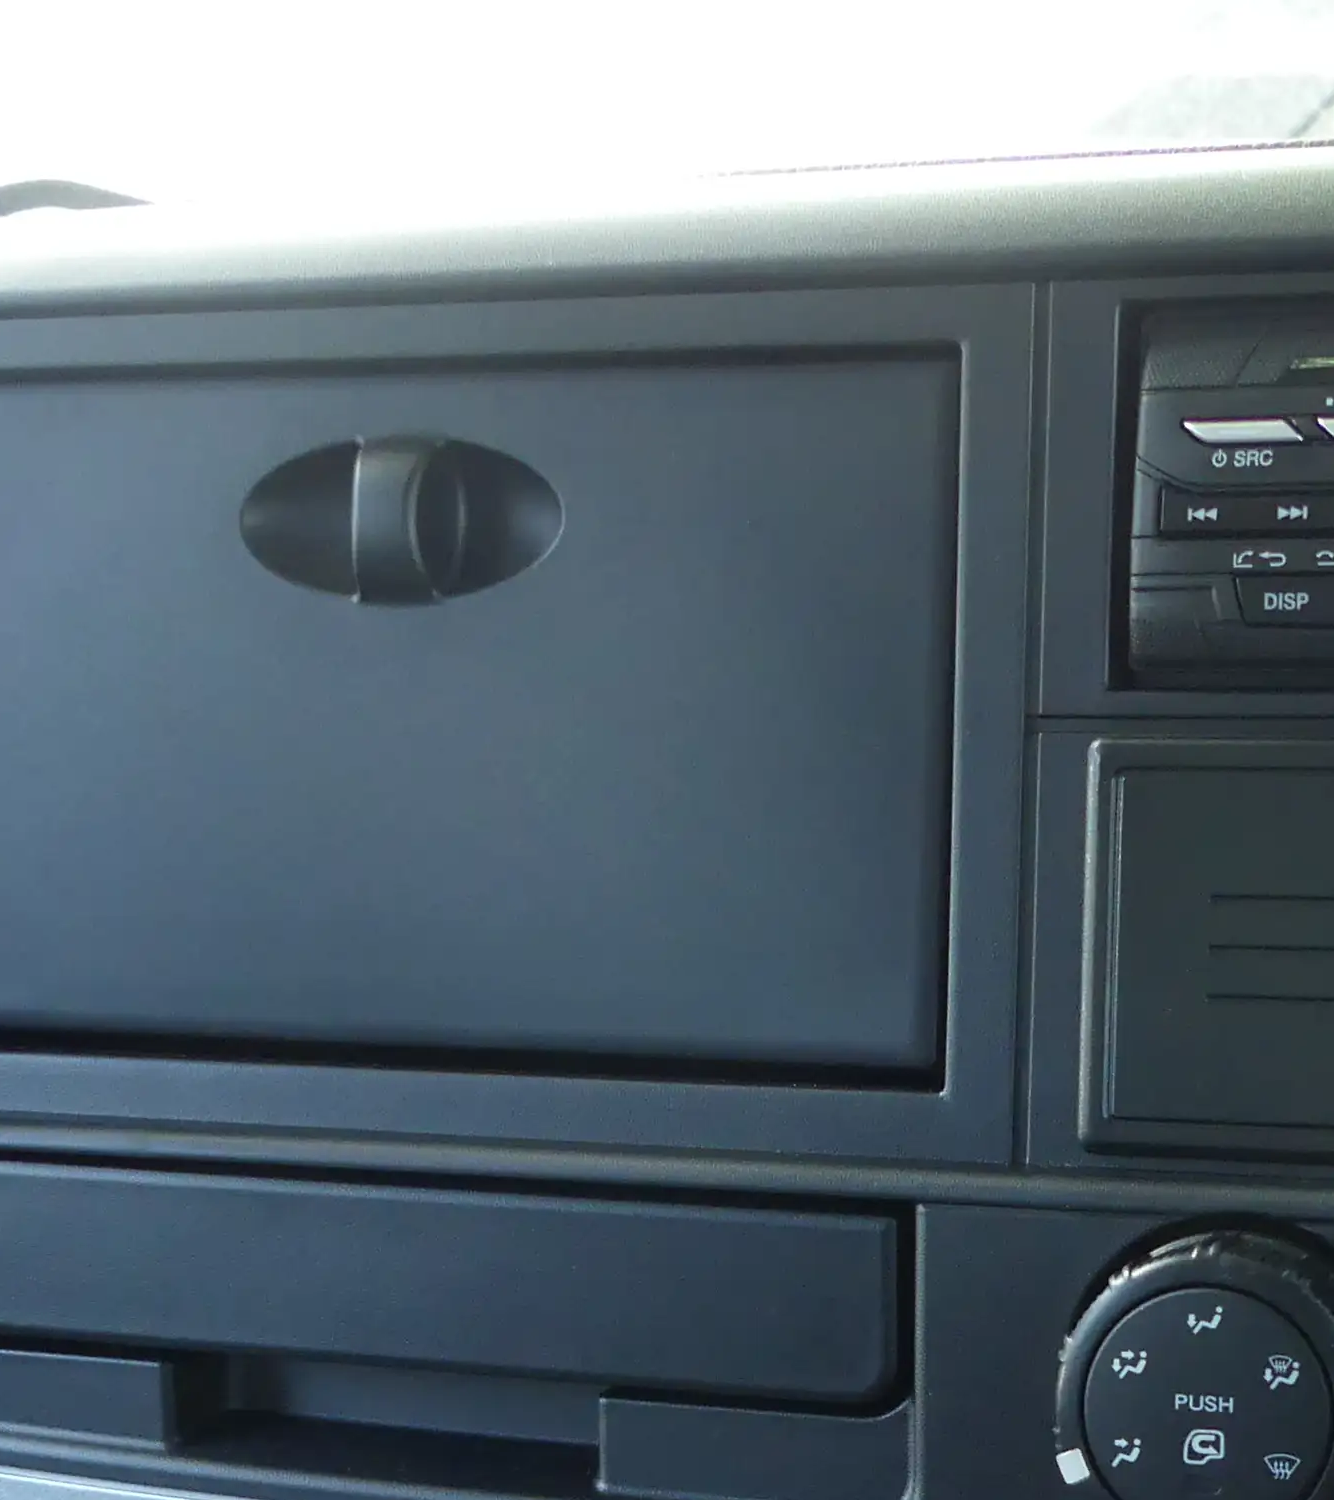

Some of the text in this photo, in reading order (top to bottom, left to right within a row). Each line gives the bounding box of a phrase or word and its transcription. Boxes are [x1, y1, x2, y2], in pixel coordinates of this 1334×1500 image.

[1233, 450, 1274, 468] SRC
[1263, 592, 1310, 611] DISP
[1174, 1393, 1235, 1414] PUSH
